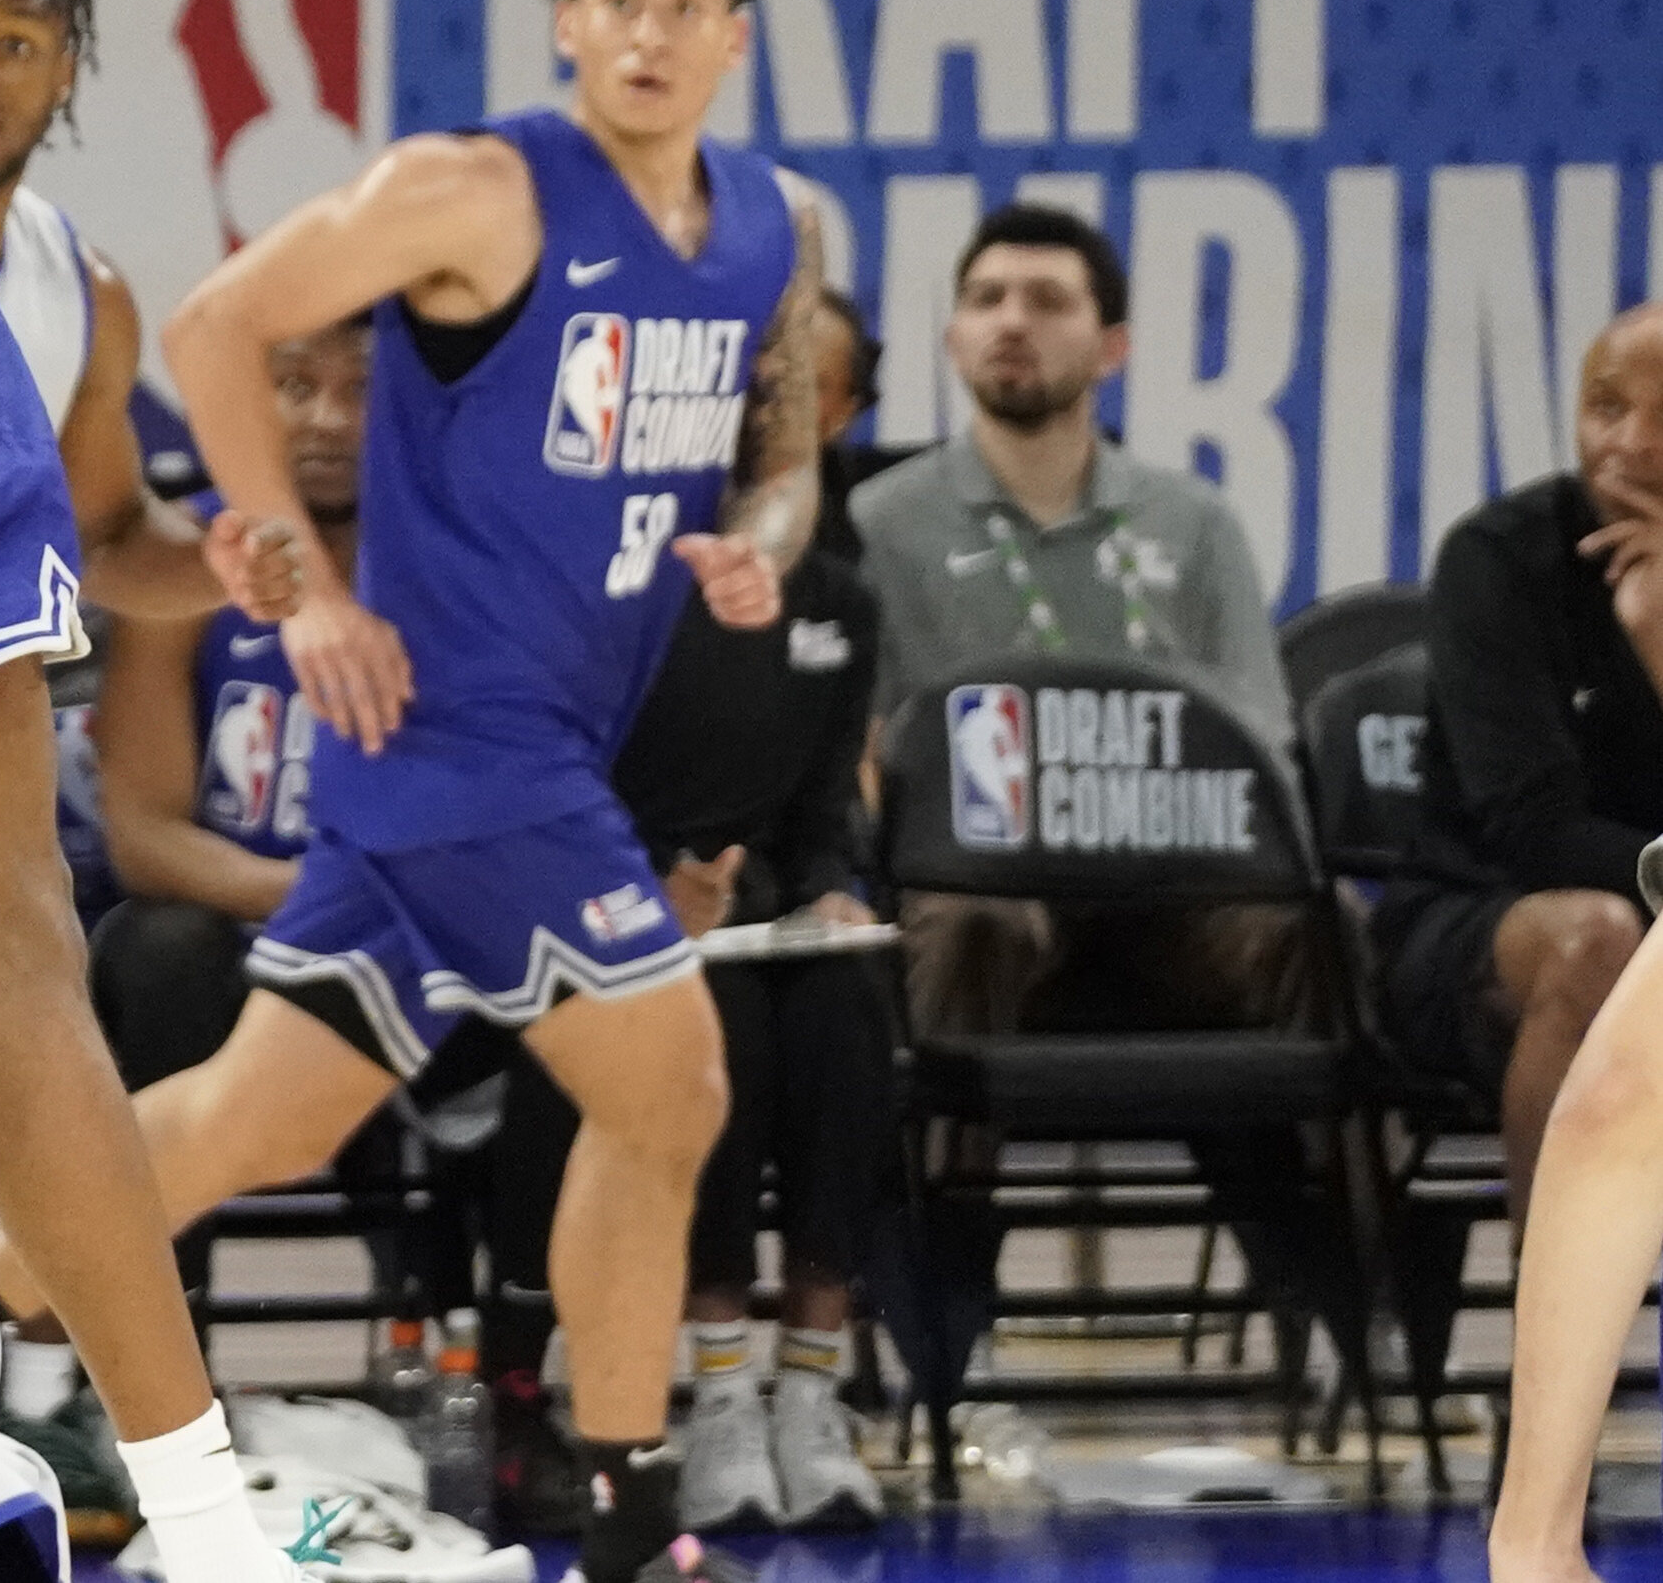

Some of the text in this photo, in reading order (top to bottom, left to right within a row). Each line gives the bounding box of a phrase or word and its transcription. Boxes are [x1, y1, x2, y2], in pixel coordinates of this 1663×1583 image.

[629, 318, 749, 395] DRAFT
[1035, 687, 1185, 766] DRAFT
[1038, 767, 1256, 853] COMBINE
